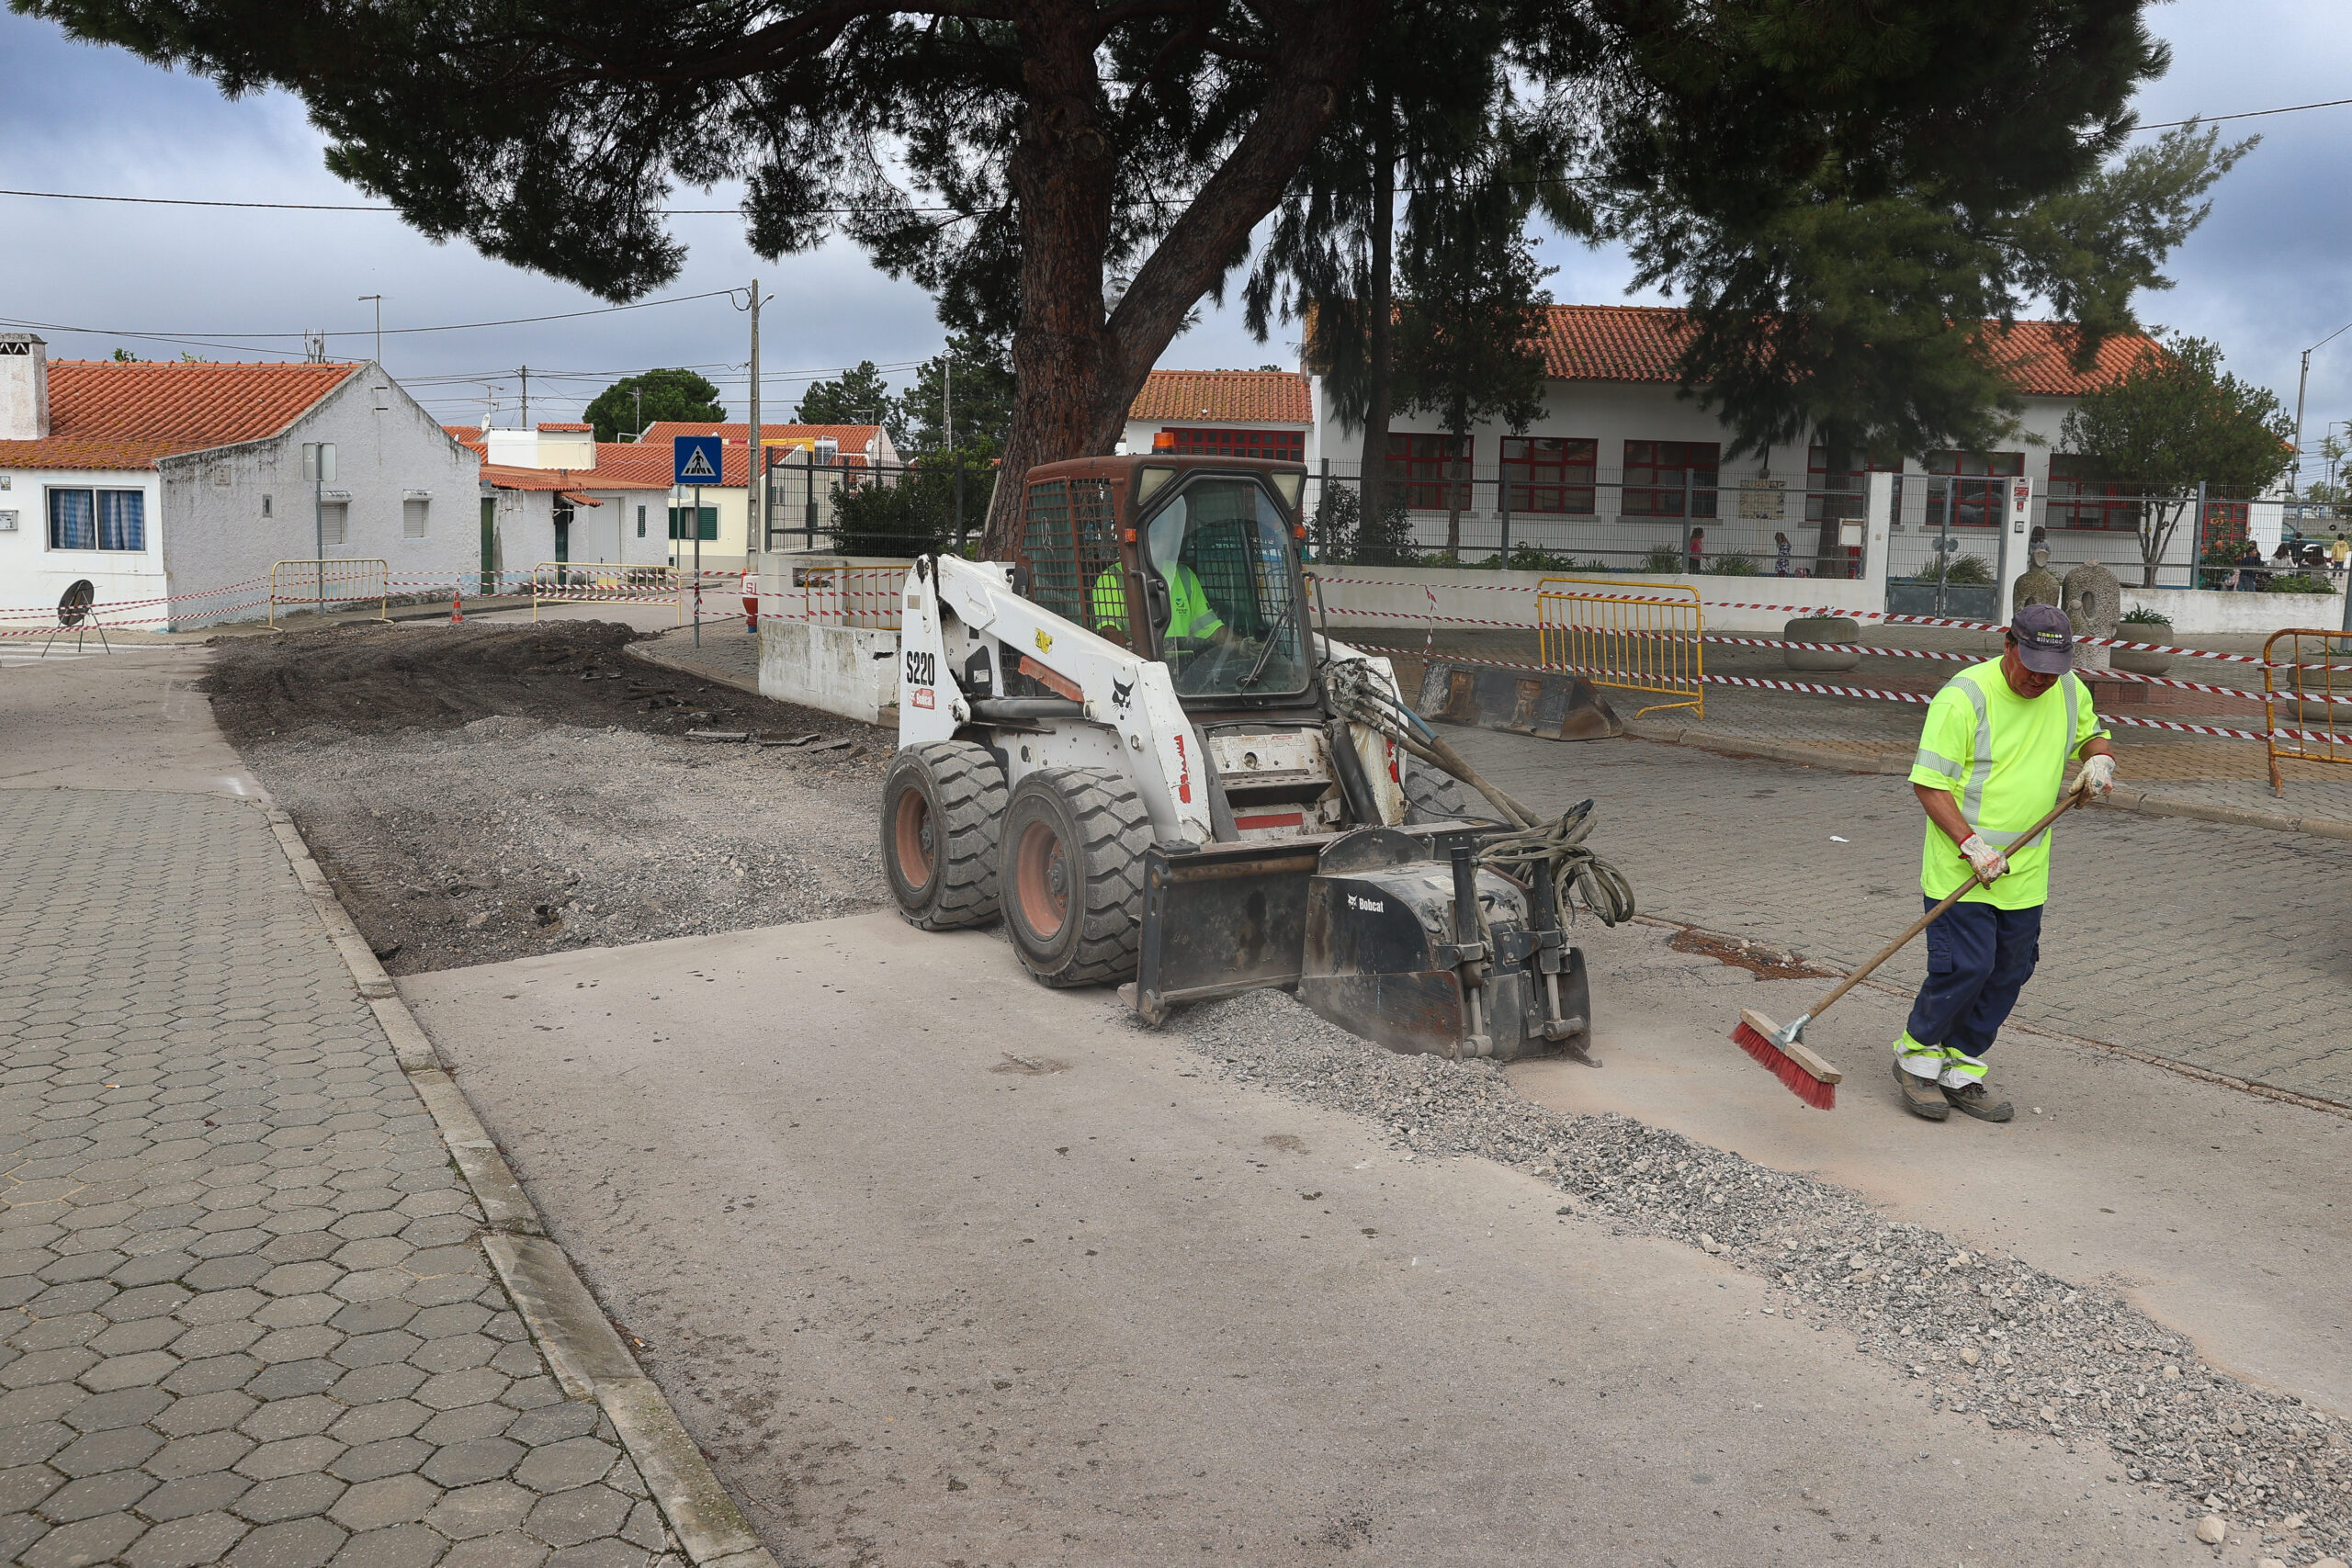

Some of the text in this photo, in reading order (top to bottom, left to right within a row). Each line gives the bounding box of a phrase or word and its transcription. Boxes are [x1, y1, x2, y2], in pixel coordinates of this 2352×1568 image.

[907, 650, 935, 686] S220
[916, 693, 934, 706] Bobcat
[1359, 897, 1384, 913] Bobcat
